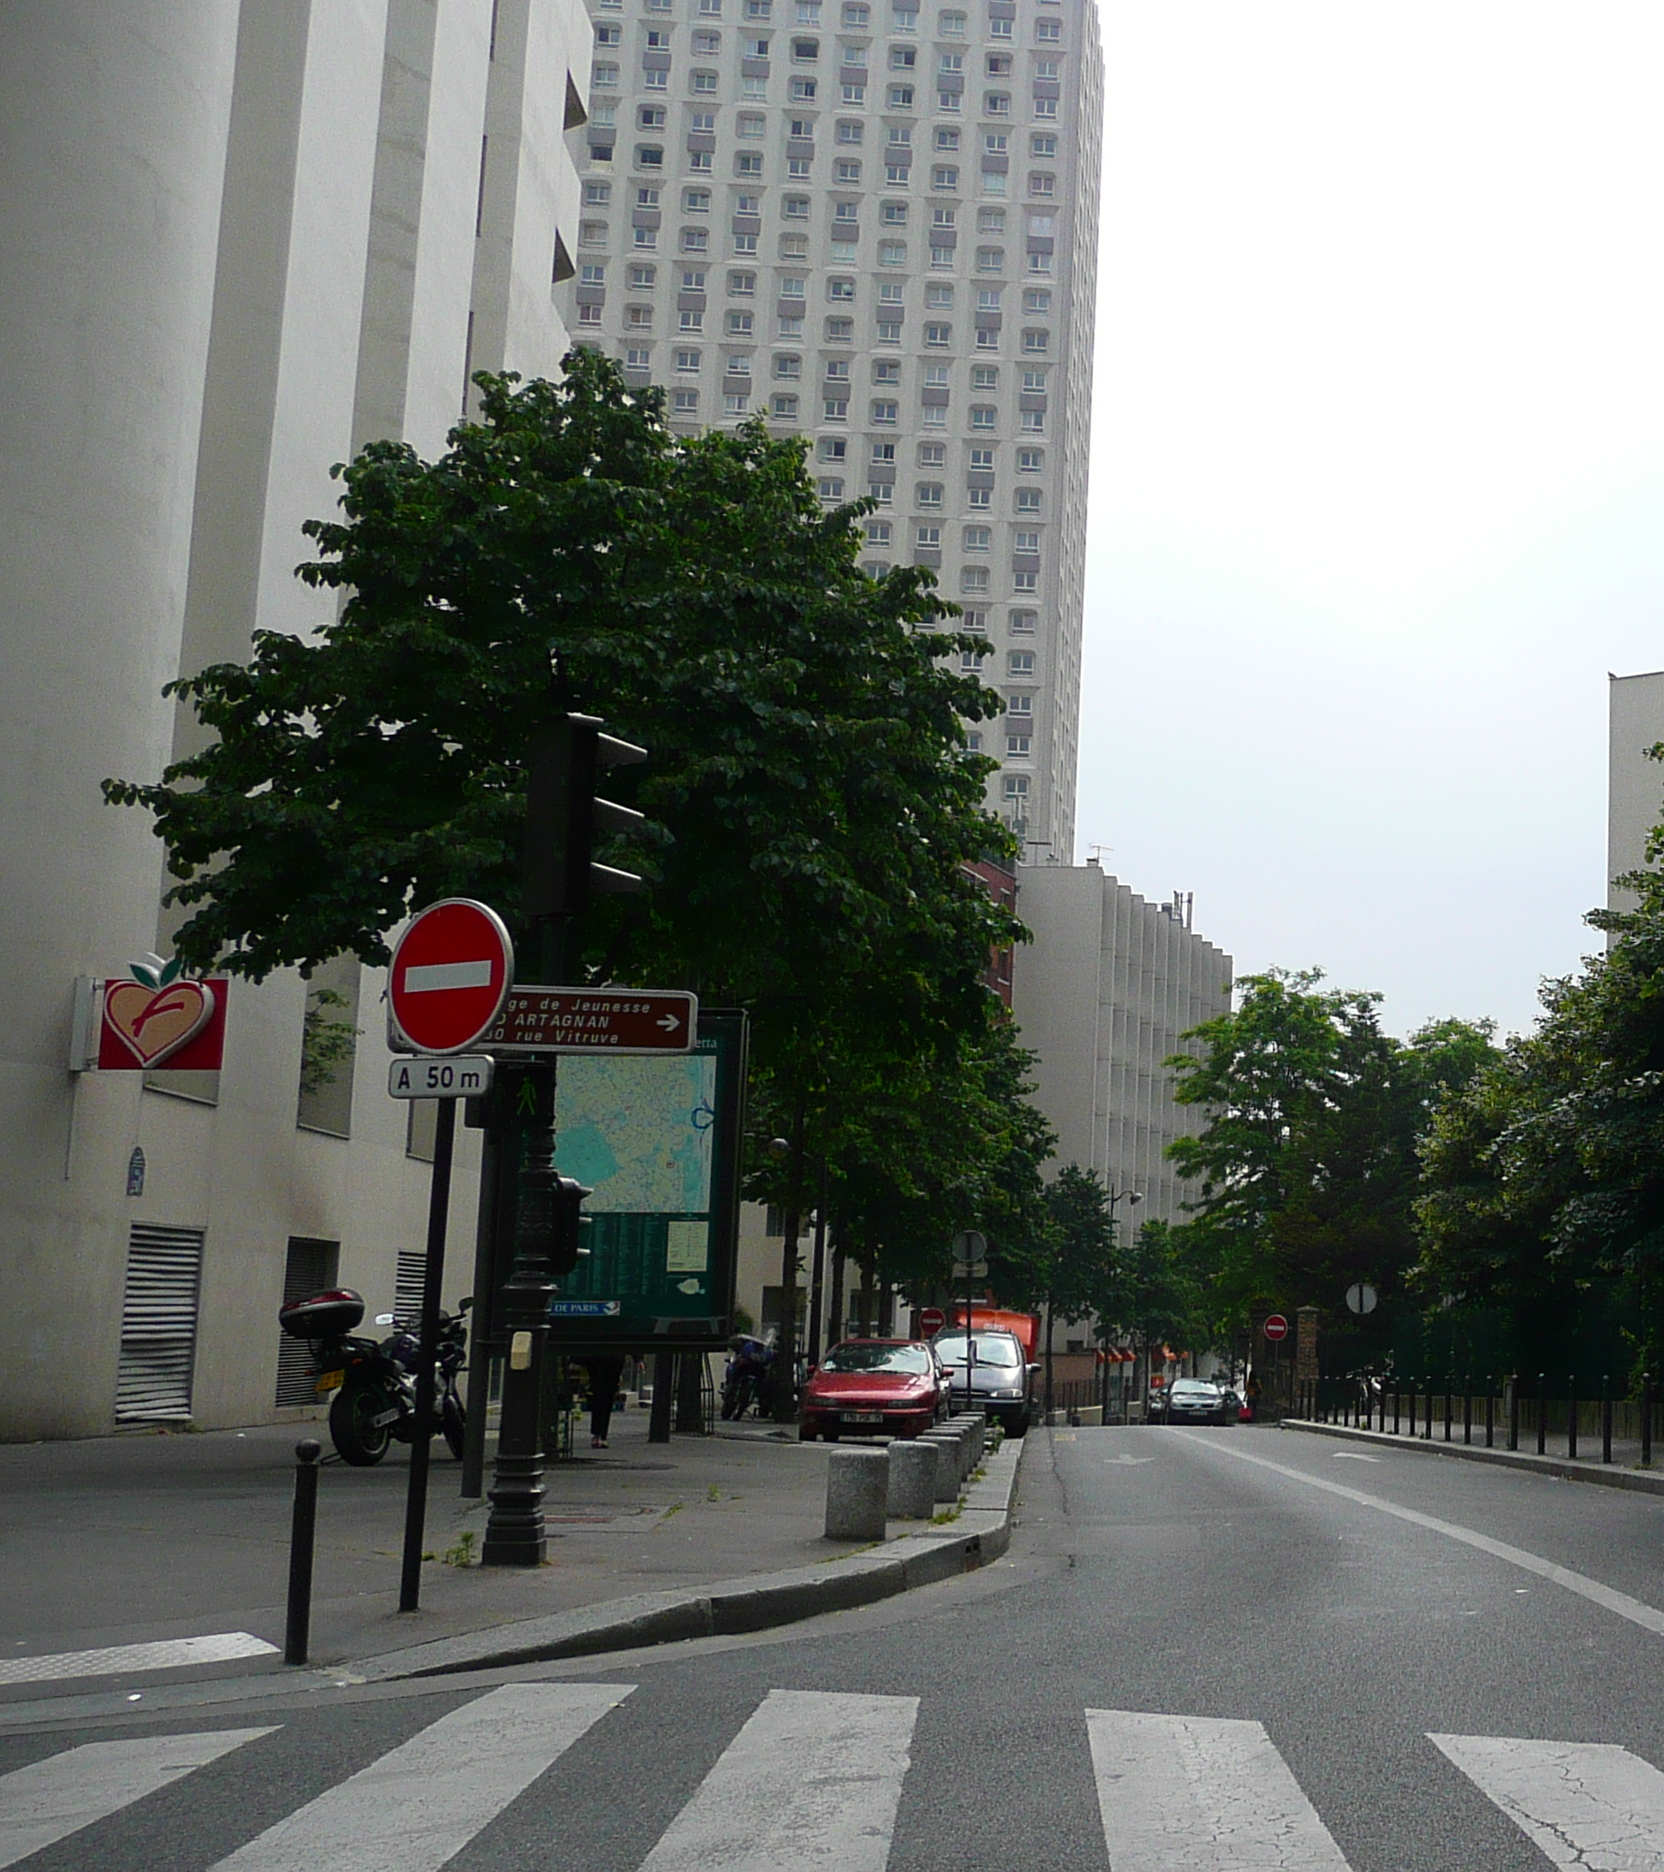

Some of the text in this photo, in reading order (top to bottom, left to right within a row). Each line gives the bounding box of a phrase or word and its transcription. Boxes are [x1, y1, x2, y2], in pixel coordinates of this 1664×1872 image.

[540, 998, 560, 1011] de
[571, 999, 650, 1014] Jeunesse
[516, 1031, 543, 1042] rue
[555, 1029, 619, 1044] Vitruve
[398, 1066, 480, 1089] A 50 m
[554, 1303, 599, 1313] DE PARIS
